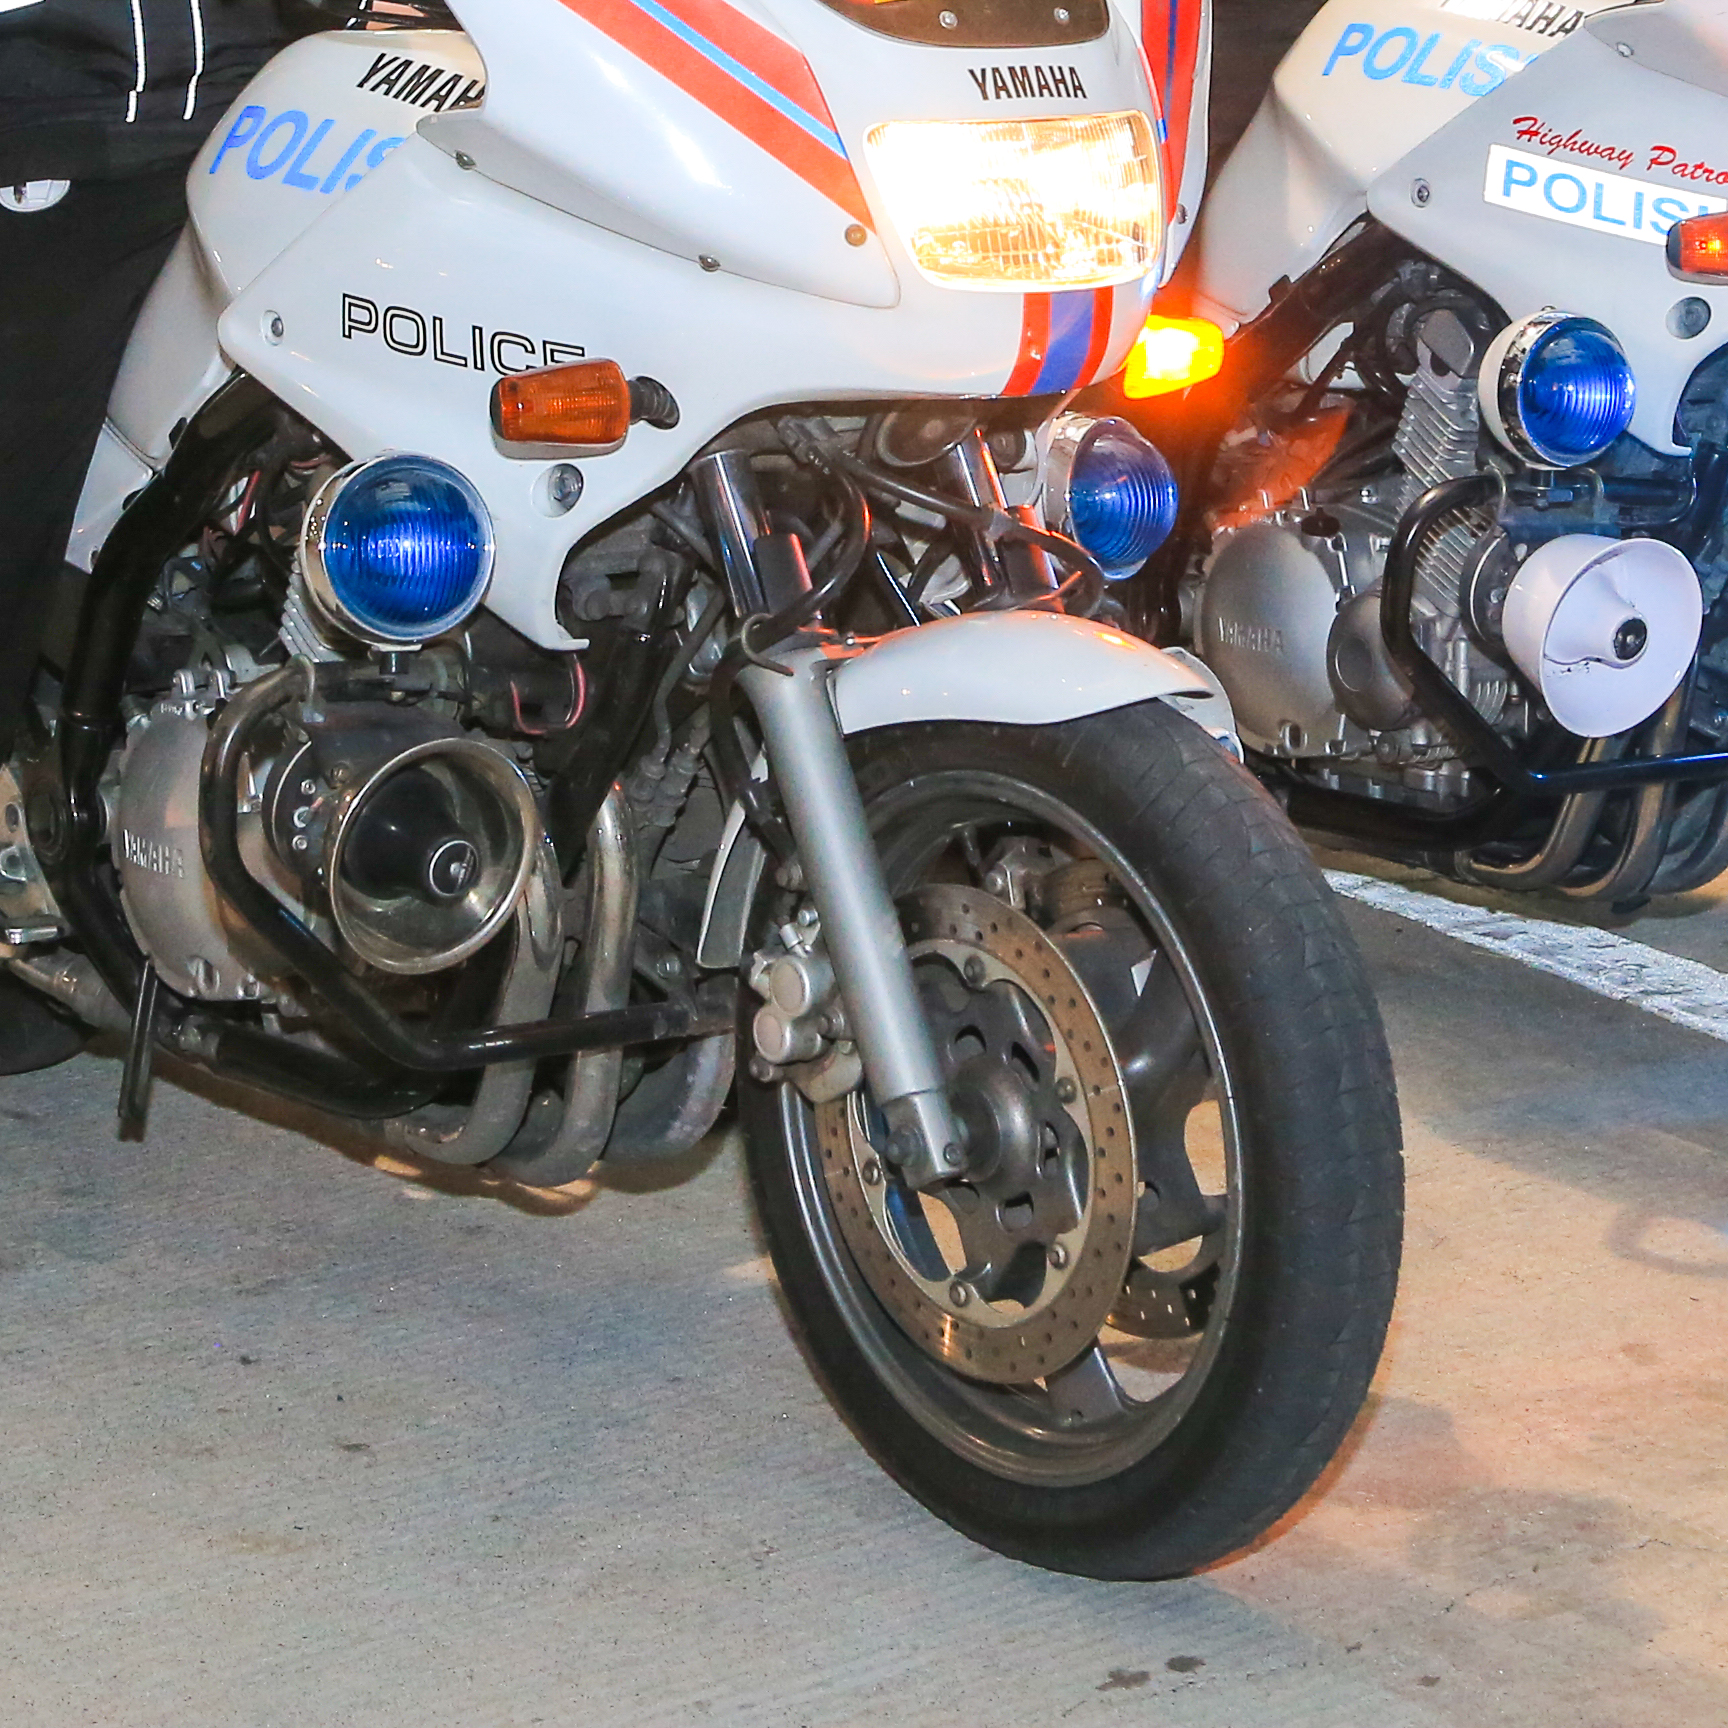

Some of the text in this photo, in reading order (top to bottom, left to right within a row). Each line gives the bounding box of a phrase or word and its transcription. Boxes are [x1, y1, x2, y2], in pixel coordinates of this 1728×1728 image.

[355, 52, 486, 114] YAMAH
[967, 65, 1089, 101] YAMAHA
[1322, 22, 1540, 98] POLIS
[1512, 115, 1635, 171] Highway
[1501, 158, 1710, 236] POLIS
[122, 827, 184, 880] YAMAHA
